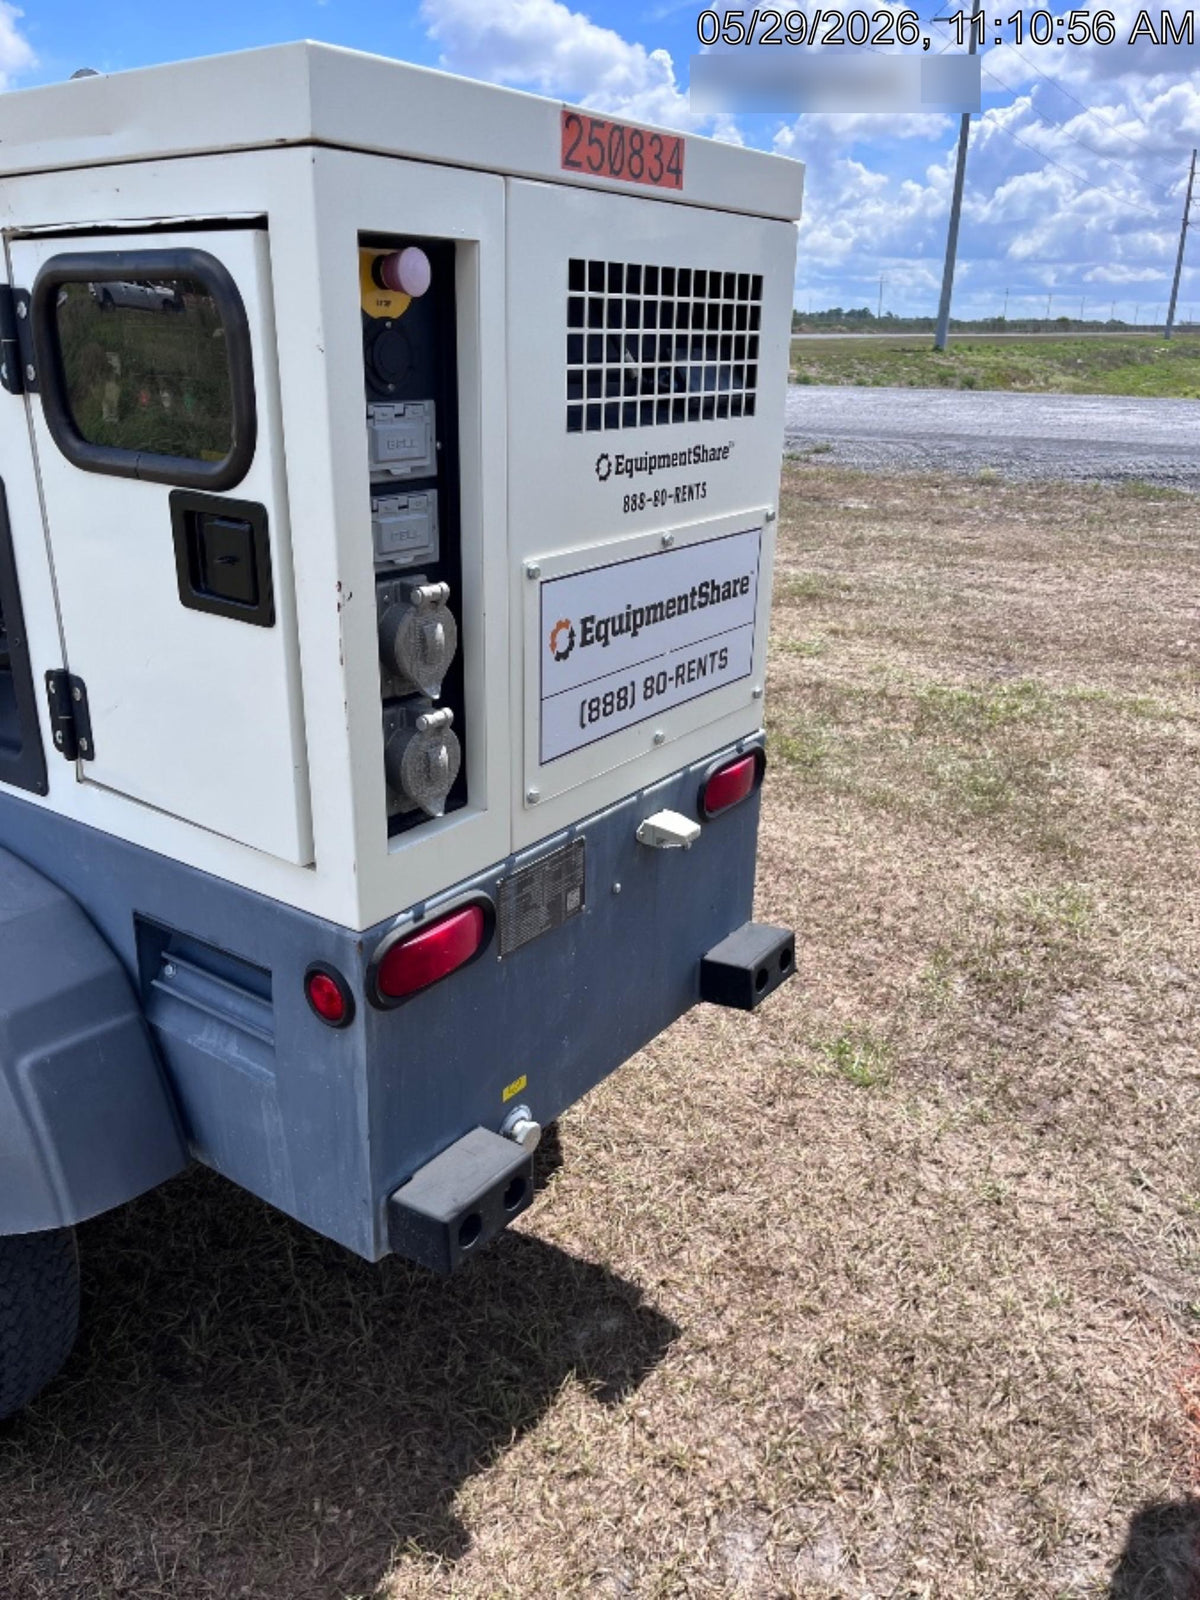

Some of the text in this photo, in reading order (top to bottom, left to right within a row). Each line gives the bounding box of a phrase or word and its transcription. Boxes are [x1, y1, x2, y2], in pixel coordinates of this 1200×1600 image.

[564, 113, 683, 186] 250834
[614, 444, 730, 479] EquipmentShare
[622, 481, 707, 514] 888-80-RENTS
[579, 575, 750, 648] EquipmentShare
[579, 647, 729, 730] (888) 80-RENTS
